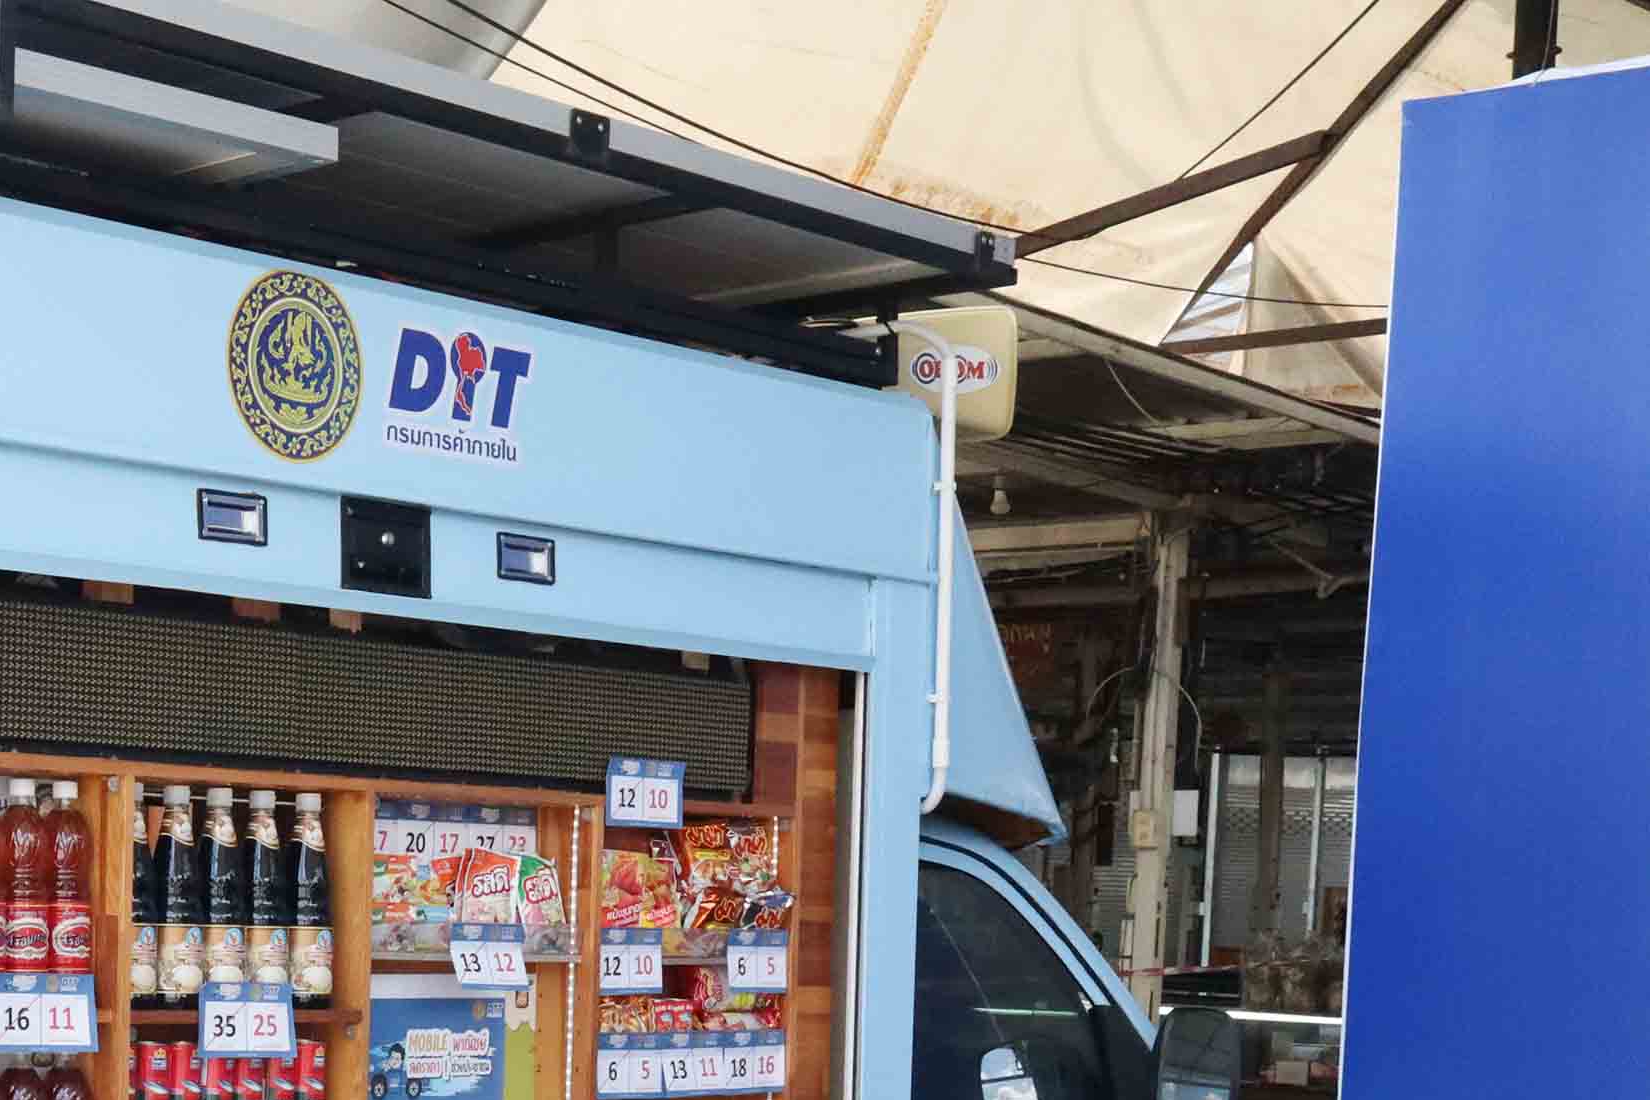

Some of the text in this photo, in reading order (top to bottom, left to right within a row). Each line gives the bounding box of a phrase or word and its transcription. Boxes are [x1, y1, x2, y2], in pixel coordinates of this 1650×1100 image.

[389, 328, 531, 428] DIT
[386, 425, 517, 462] กรมการค้าภายใน
[618, 788, 668, 809] 12 10
[406, 832, 459, 853] 20 17
[472, 865, 511, 898] รสดี
[460, 953, 516, 973] 13 12
[603, 956, 653, 976] 12 10
[737, 957, 775, 976] 6 5
[4, 1007, 75, 1032] 16 11
[213, 1014, 278, 1038] 35 25
[409, 1032, 448, 1051] MOBILE
[608, 1060, 650, 1081] 6 5
[670, 1057, 718, 1079] 13 11
[731, 1056, 775, 1077] 18 16
